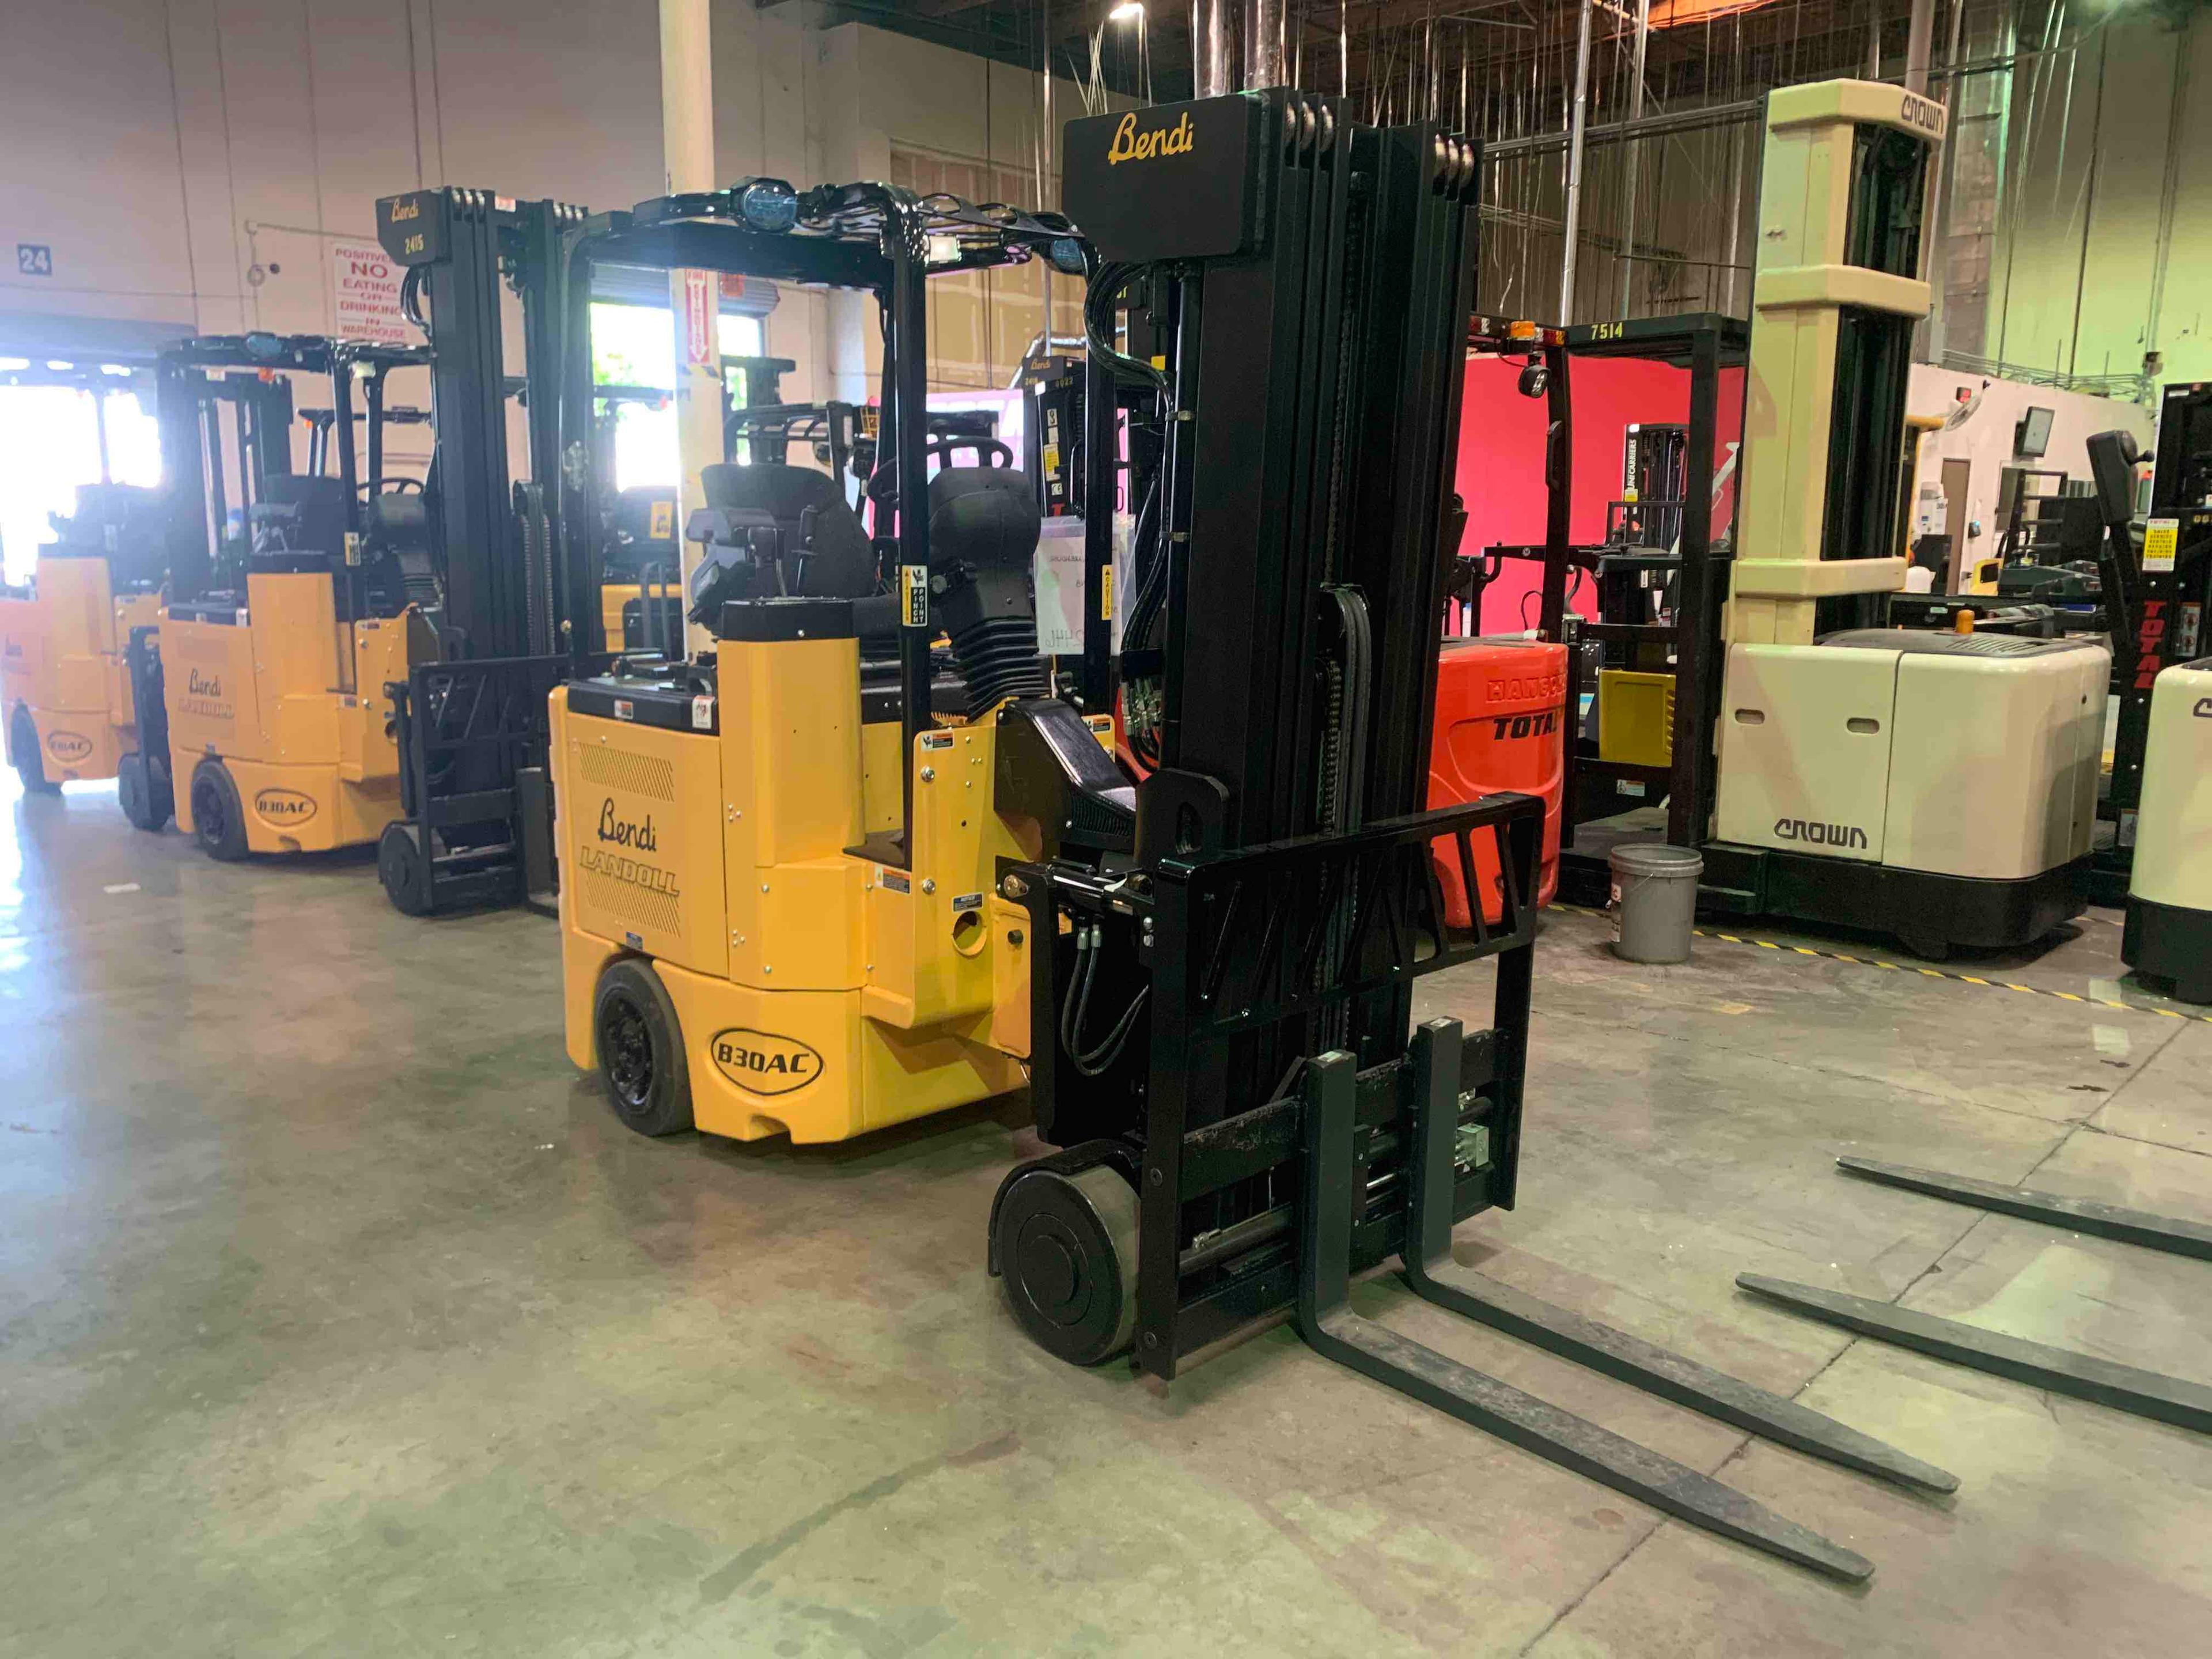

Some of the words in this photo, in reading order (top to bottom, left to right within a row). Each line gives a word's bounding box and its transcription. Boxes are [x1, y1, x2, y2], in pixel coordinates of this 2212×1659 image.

[1107, 112, 1194, 165] Bendi
[391, 197, 419, 224] Bendi
[20, 248, 47, 271] 24
[351, 262, 388, 279] NO
[343, 278, 397, 293] EATING
[341, 325, 404, 339] WAREHOUSE
[1591, 321, 1623, 340] 7514
[189, 667, 222, 698] Bendi
[597, 797, 657, 853] Bendi
[579, 844, 680, 897] LANDOLL
[717, 1042, 810, 1074] B30AC
